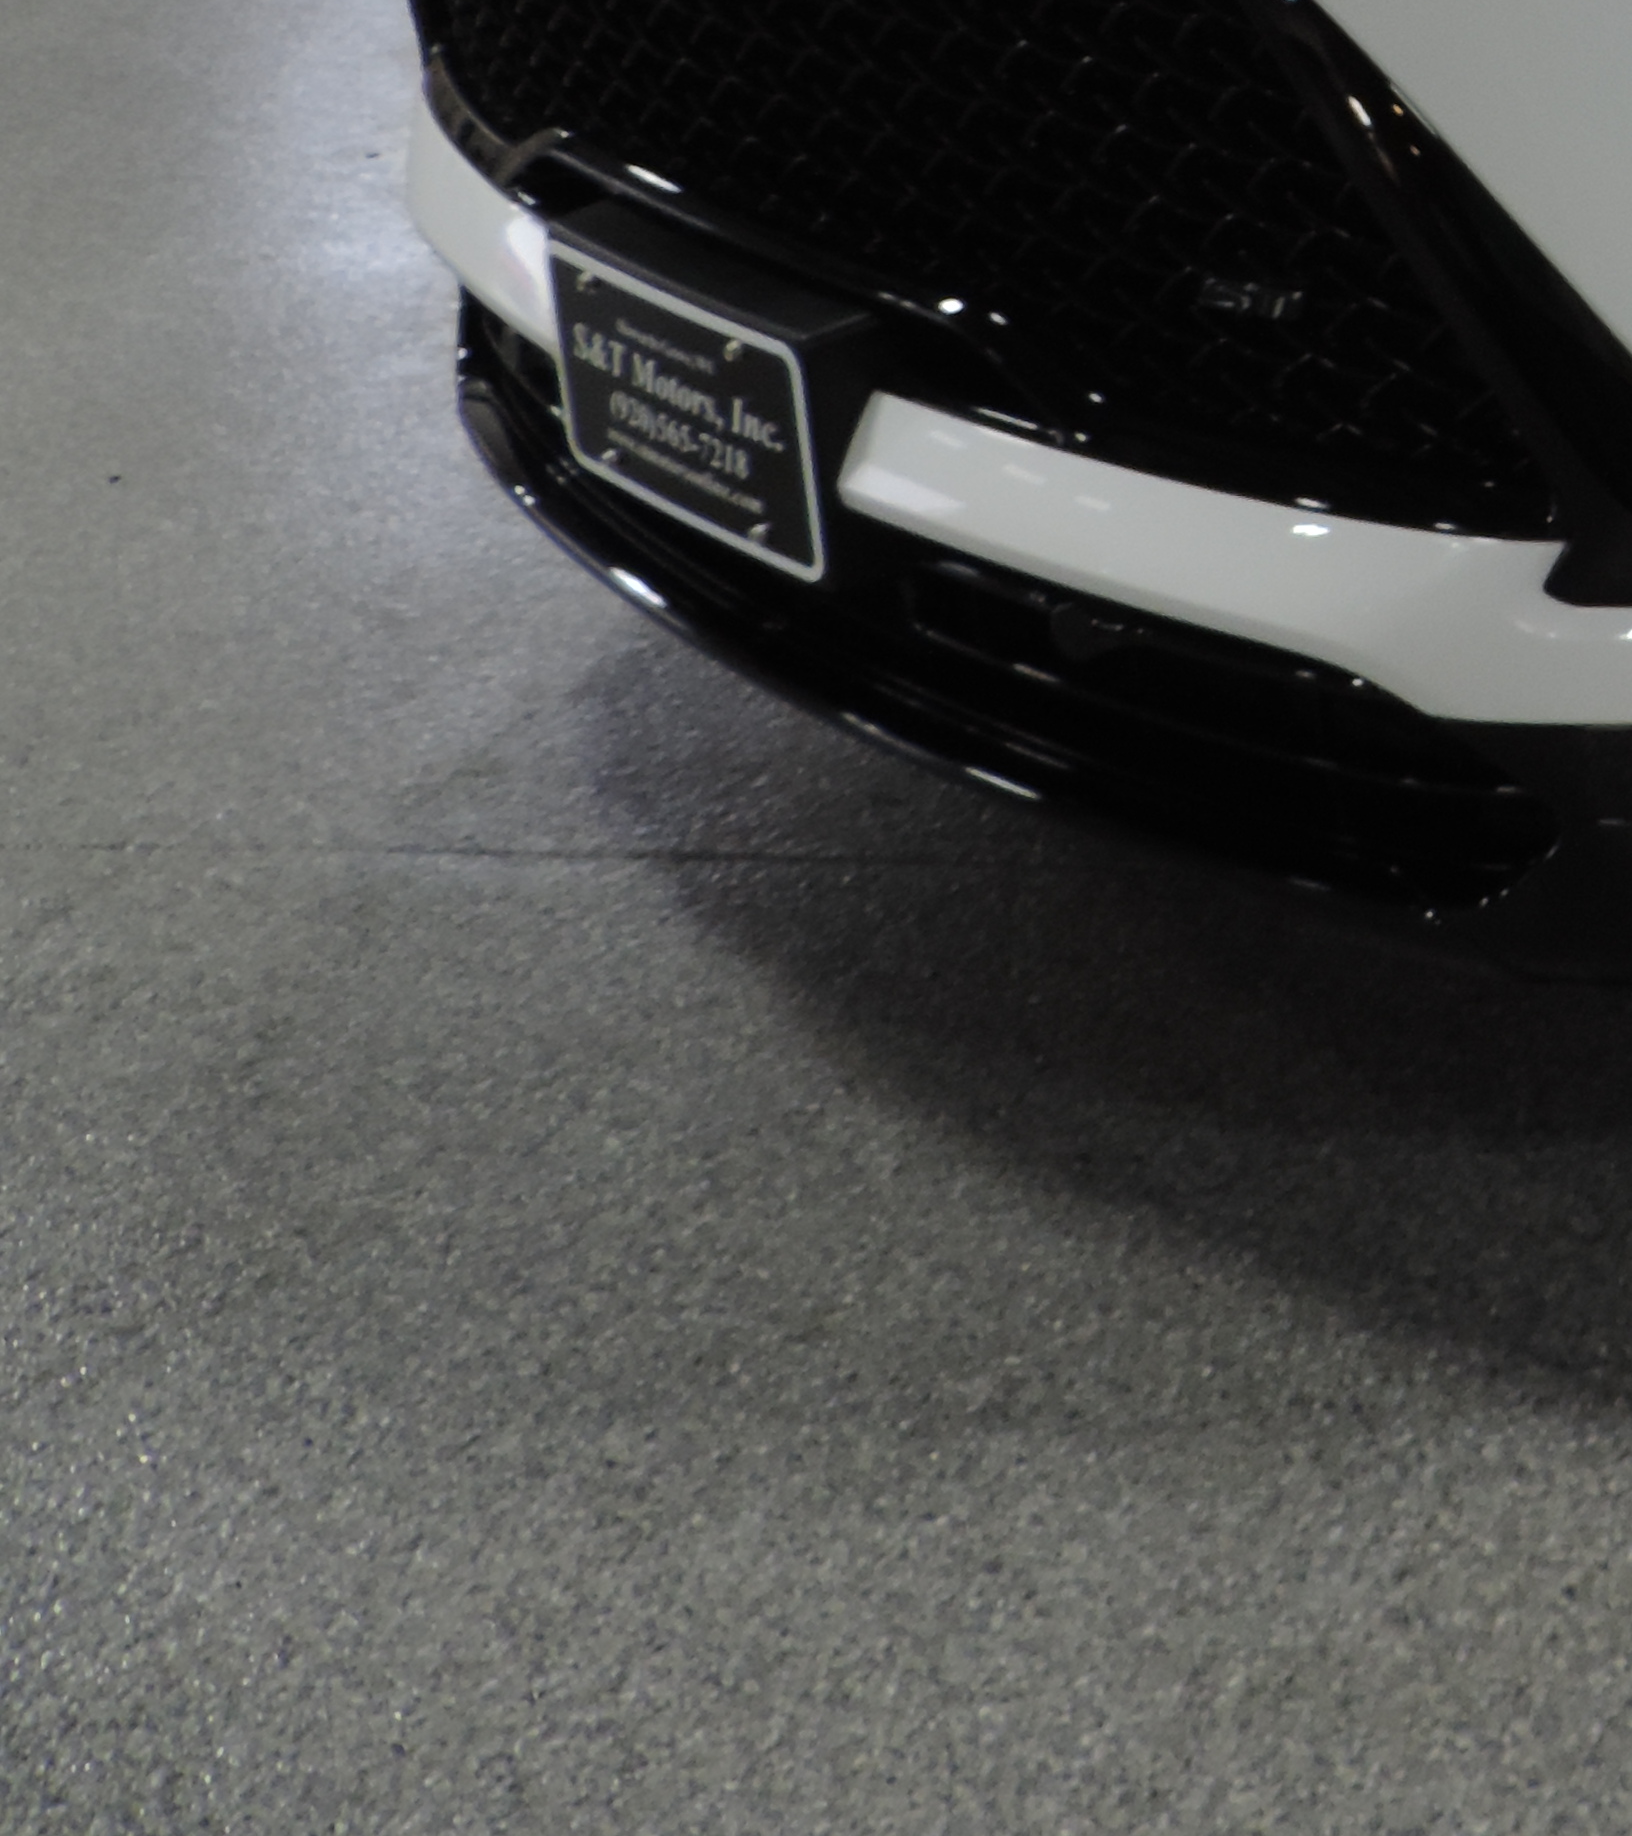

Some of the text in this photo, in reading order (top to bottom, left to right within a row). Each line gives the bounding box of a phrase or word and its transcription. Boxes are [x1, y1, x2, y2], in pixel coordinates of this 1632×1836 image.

[572, 321, 625, 378] S&T
[631, 351, 725, 432] Motors,
[731, 397, 785, 454] Inc.
